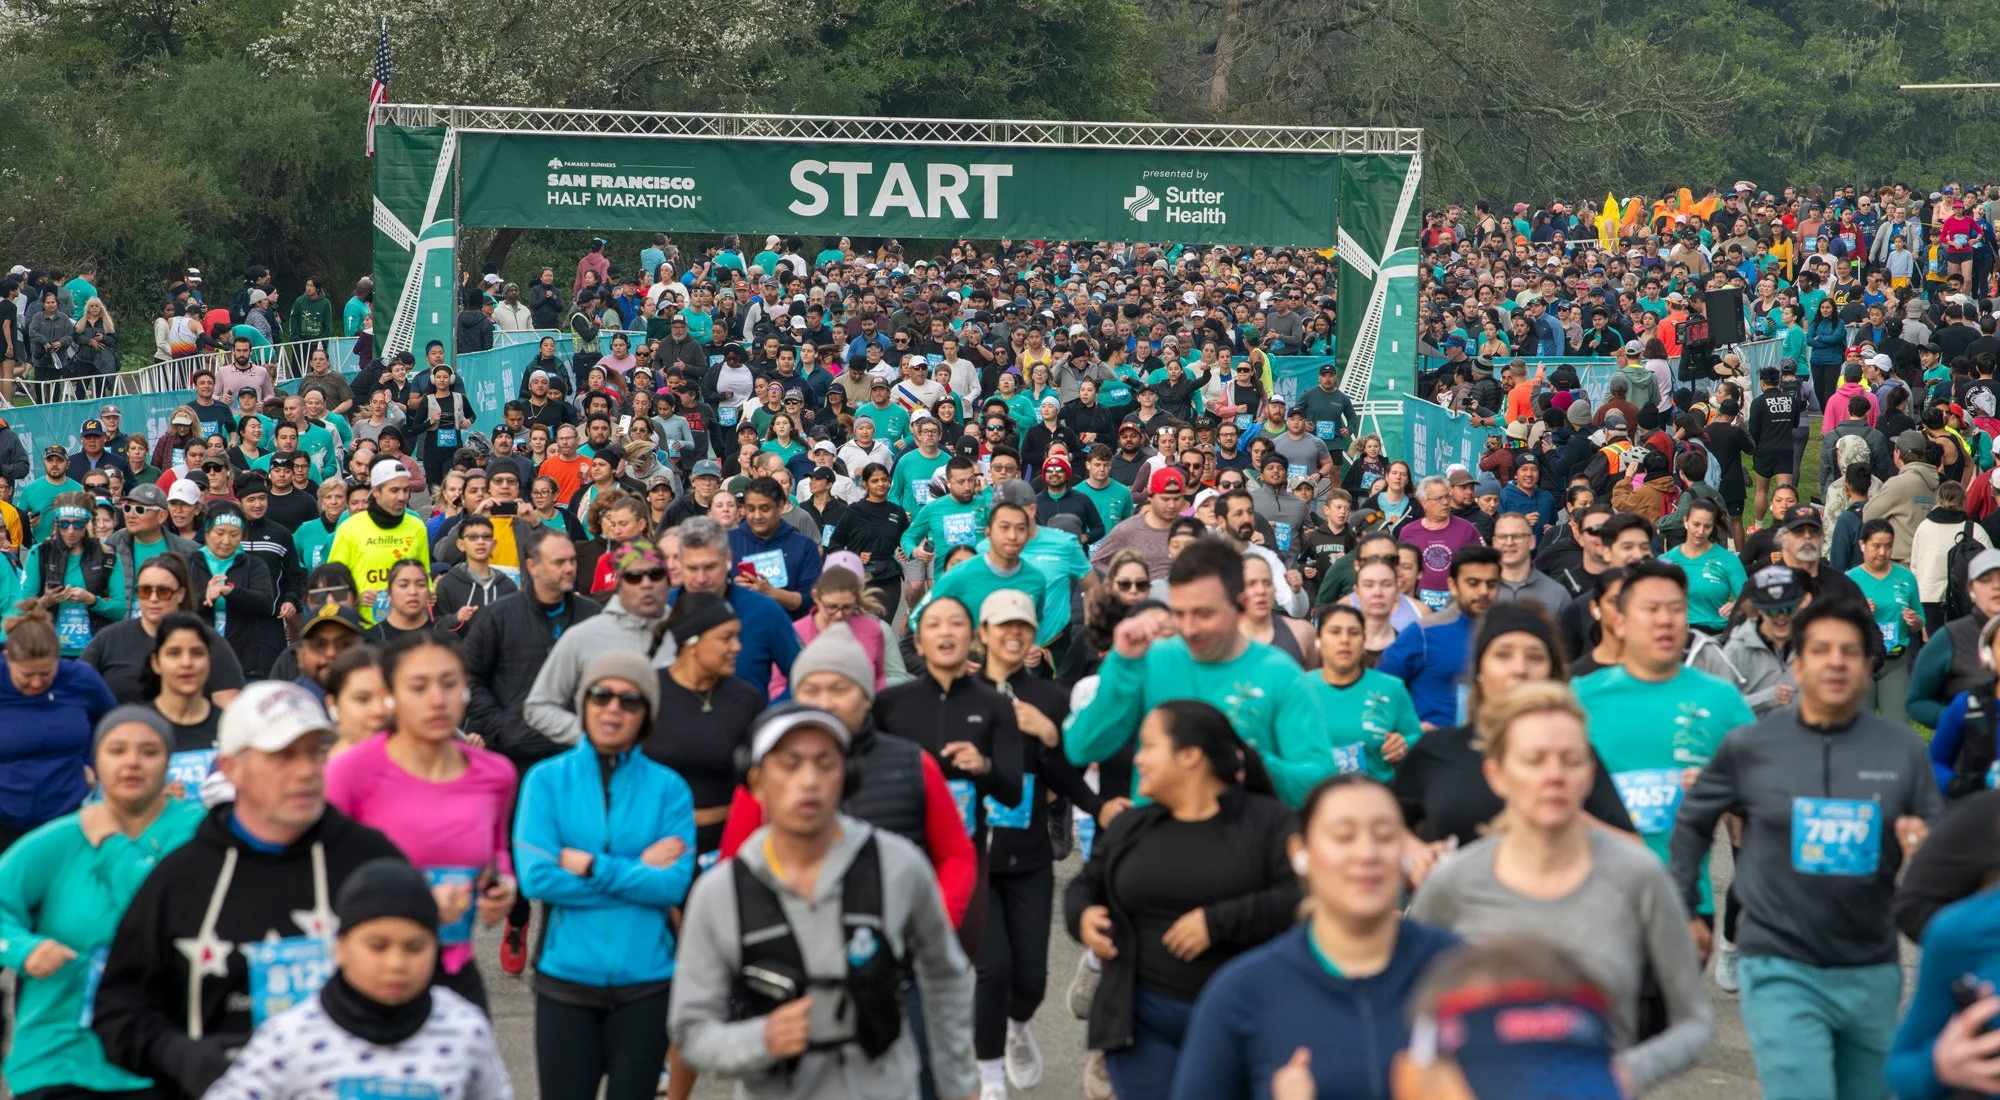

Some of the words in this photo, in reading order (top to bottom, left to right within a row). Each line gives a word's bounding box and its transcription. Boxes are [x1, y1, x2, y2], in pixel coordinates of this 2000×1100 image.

[547, 173, 587, 188] SAN
[590, 174, 696, 191] FRANCISCO
[1143, 169, 1194, 179] presented
[1196, 169, 1208, 181] by
[788, 159, 1013, 219] START
[1165, 186, 1225, 204] Sutter
[547, 191, 592, 206] HALF
[1166, 206, 1226, 224] Health
[1833, 289, 1850, 306] Cal
[1765, 396, 1793, 406] RUSH
[1769, 404, 1792, 414] CLUB
[86, 422, 97, 430] Cal
[147, 418, 170, 440] SA
[366, 535, 404, 546] Achilles
[1315, 544, 1323, 554] SF
[1323, 543, 1345, 553] UNITED
[366, 569, 391, 583] GU
[61, 623, 89, 634] 7735
[1621, 786, 1677, 809] 7657
[1804, 819, 1869, 845] 7879
